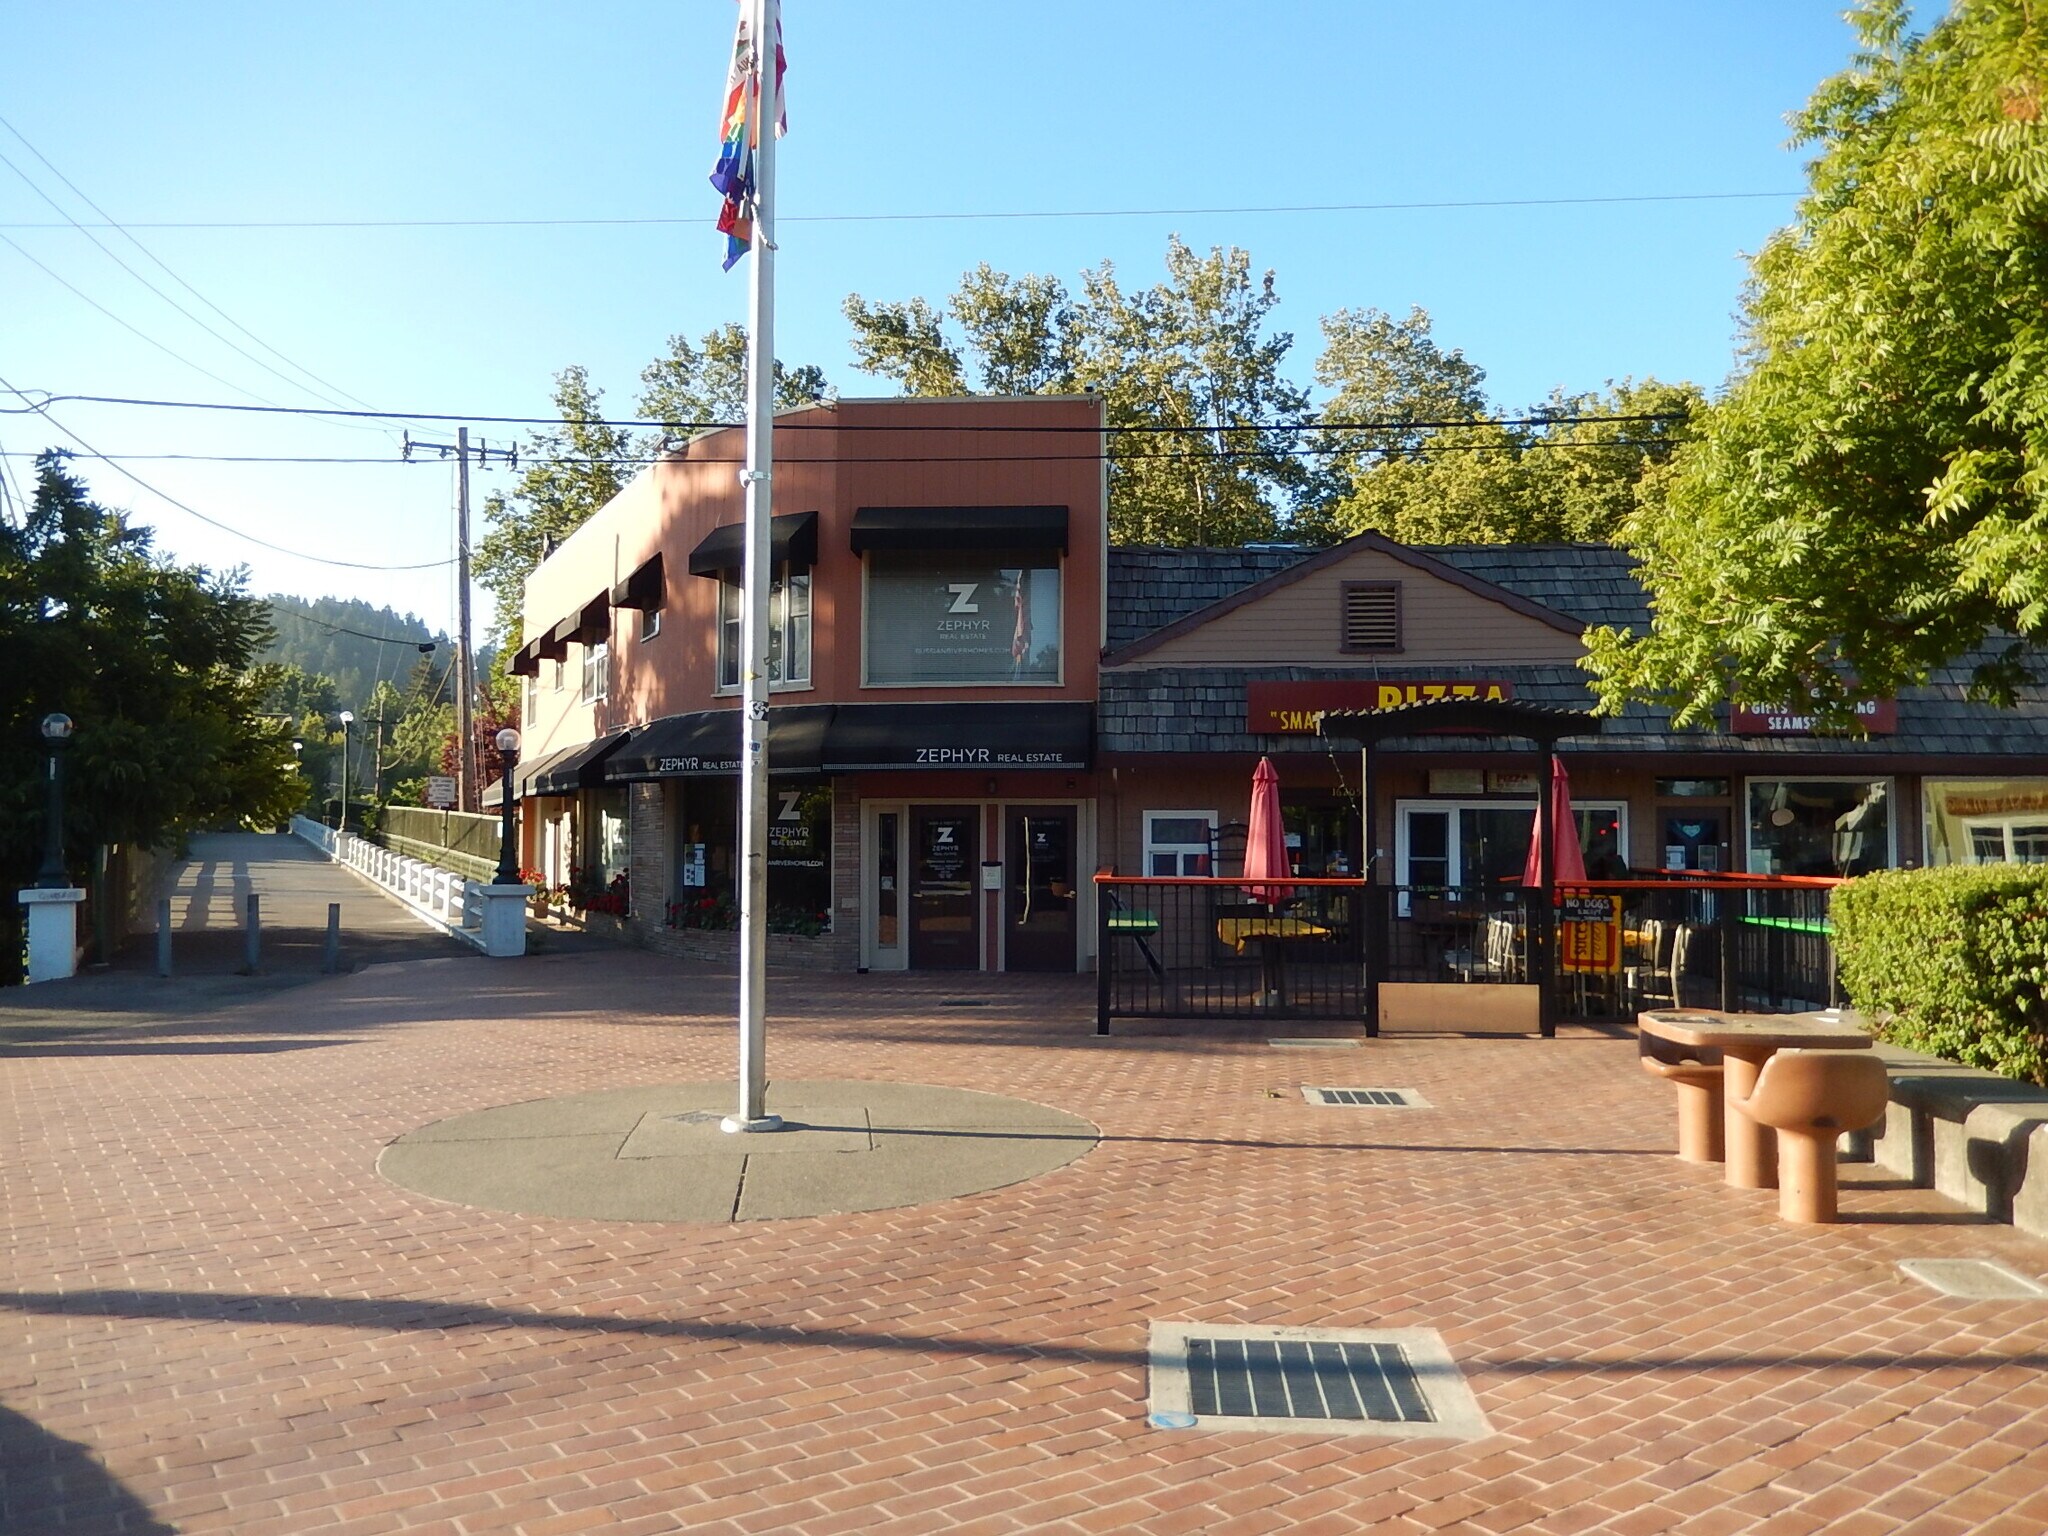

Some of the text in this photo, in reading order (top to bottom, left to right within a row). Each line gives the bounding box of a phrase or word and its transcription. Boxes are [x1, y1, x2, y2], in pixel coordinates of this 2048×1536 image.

[948, 583, 979, 613] Z
[937, 620, 990, 631] ZEPHYR
[1270, 710, 1314, 730] "SMA
[916, 748, 1062, 763] ZEPHYR REAL ESTATE
[660, 757, 699, 771] ZEPHYR
[703, 761, 719, 769] REAL
[777, 791, 801, 820] Z
[769, 827, 810, 837] ZEPHYR
[937, 827, 954, 843] Z
[1565, 899, 1610, 910] NO DOGS
